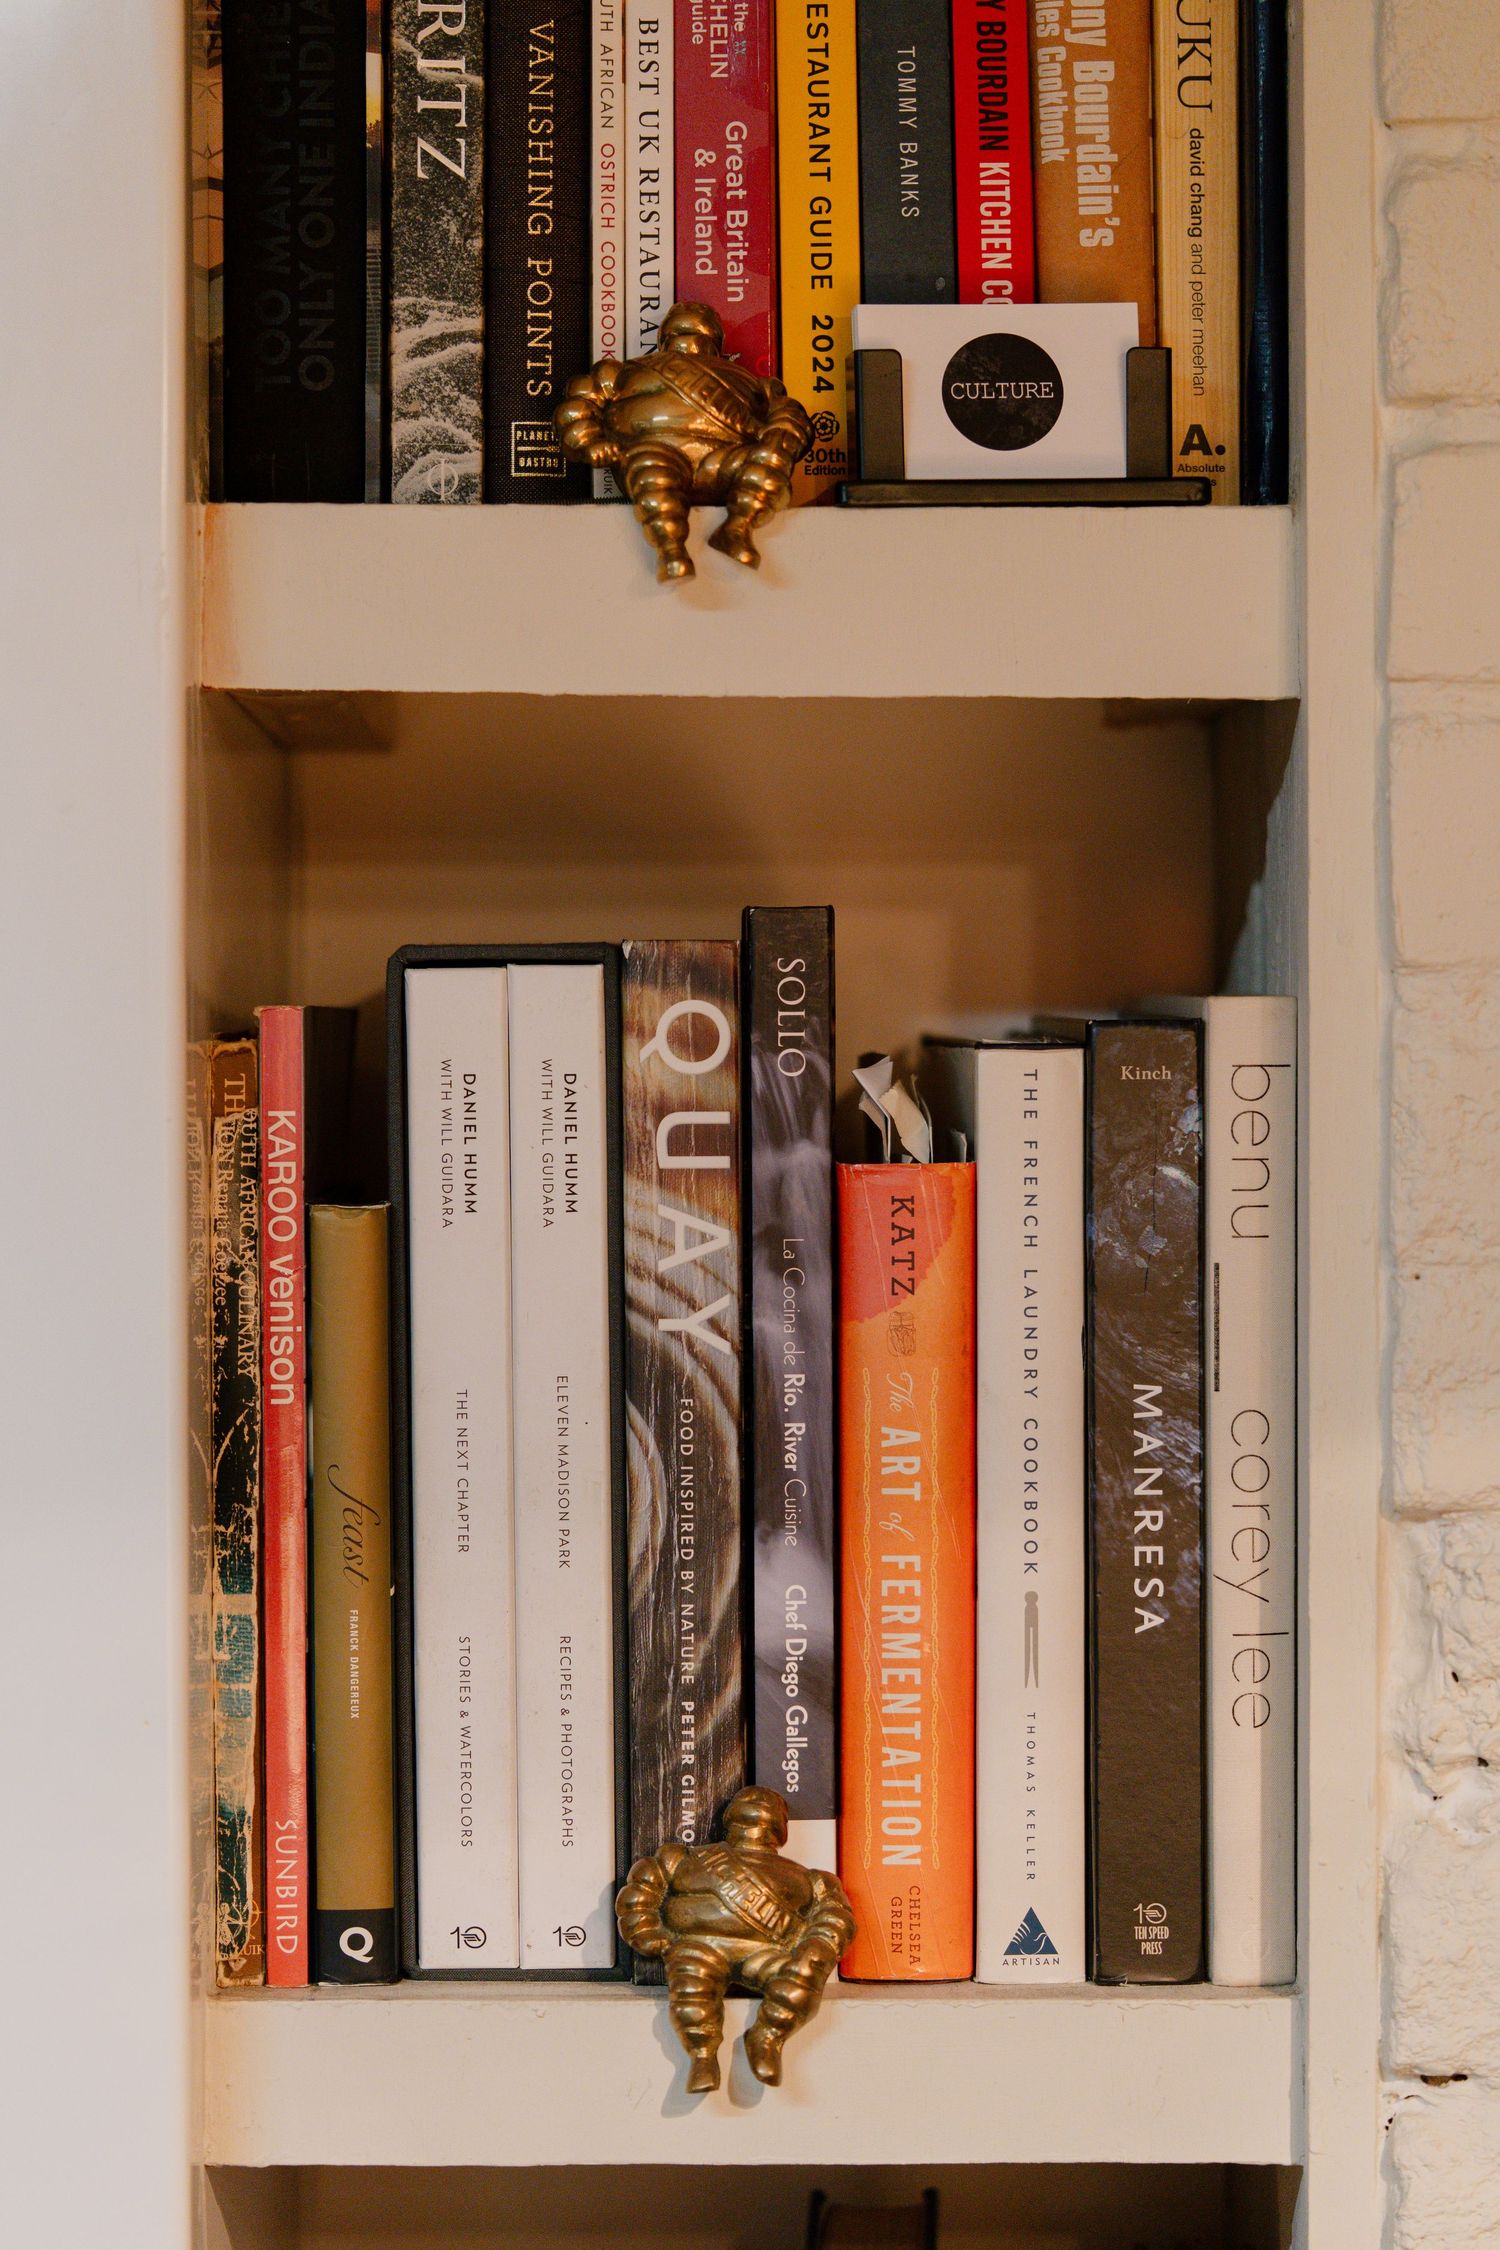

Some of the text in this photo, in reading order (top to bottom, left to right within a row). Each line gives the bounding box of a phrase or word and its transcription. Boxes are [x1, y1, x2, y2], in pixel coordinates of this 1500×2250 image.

[638, 18, 660, 95] BEST
[710, 0, 729, 78] HELIN
[733, 3, 749, 32] the
[416, 0, 467, 180] RITZ
[600, 44, 614, 128] AFRICAN
[639, 109, 661, 154] UK
[897, 46, 920, 218] TOMMY BANKS
[977, 21, 1010, 151] BOURDAIN
[1036, 46, 1070, 164] Cookbook
[299, 144, 334, 248] ONE
[600, 143, 616, 228] OSTRICH
[805, 4, 835, 393] ESTAURANT GUIDE 2024
[1072, 61, 1121, 247] Bourdain's
[1189, 128, 1203, 178] david
[527, 20, 554, 397] VANISHING POINTS
[693, 149, 719, 276] & Ireland
[725, 121, 751, 302] Great Britain
[979, 162, 1013, 270] KITCHEN
[1187, 183, 1204, 237] chang
[1190, 243, 1203, 275] and
[299, 263, 334, 390] ONLY
[600, 241, 617, 360] COOKBOOK
[1188, 280, 1204, 324] peter
[950, 380, 1055, 400] CULTURE
[1191, 329, 1204, 396] meehan
[804, 448, 847, 463] 30th
[804, 465, 846, 476] Edition
[1177, 464, 1225, 473] Absolute
[777, 957, 807, 1077] SOLLO
[1120, 1065, 1172, 1080] Kinch
[440, 1059, 454, 1228] WITH WILL GUIDARA
[463, 1073, 478, 1214] DANIEL HUMM
[541, 1059, 555, 1228] WITH WILL GUIDARA
[563, 1073, 579, 1214] DANIEL HUMM
[640, 1000, 731, 1355] QUAY
[1231, 1064, 1291, 1238] benu
[239, 1175, 257, 1264] AFRICAN
[268, 1110, 302, 1405] KAROO venison
[891, 1195, 915, 1297] KATZ
[238, 1271, 257, 1380] CULINARY
[1023, 1070, 1038, 1574] THE FRENCH LAUNDRY COOKBOOK
[456, 1390, 470, 1553] THE NEXT CHAPTER
[556, 1376, 571, 1569] ELEVEN MADISON PARK
[680, 1399, 694, 1456] FOOD
[680, 1466, 695, 1560] INSPIRED
[781, 1239, 807, 1792] La Cocina de Río. River Cuisine Chef Diego Gallegos
[1133, 1383, 1165, 1634] MANRESA
[328, 1464, 381, 1719] feast FRANCK DANGEREUX
[680, 1570, 694, 1593] BY
[878, 1372, 922, 1866] The ART of FERMENTATION
[1213, 1409, 1290, 1729] corey lee
[680, 1604, 695, 1684] NATURE
[459, 1636, 473, 1848] STORIES & WATERCOLORS
[560, 1636, 574, 1848] RECIPES & PHOTOGRAPHS
[680, 1701, 695, 1765] PETER
[1026, 1713, 1036, 1881] THOMAS KELLER
[275, 1820, 298, 1953] SUNBIRD
[891, 1897, 902, 1954] GREEN
[908, 1886, 920, 1966] CHELSEA
[1134, 1926, 1170, 1940] TEN SPEED
[339, 1926, 373, 1964] Q
[1002, 1957, 1060, 1966] ARTISAN
[1141, 1942, 1162, 1955] PRESS
